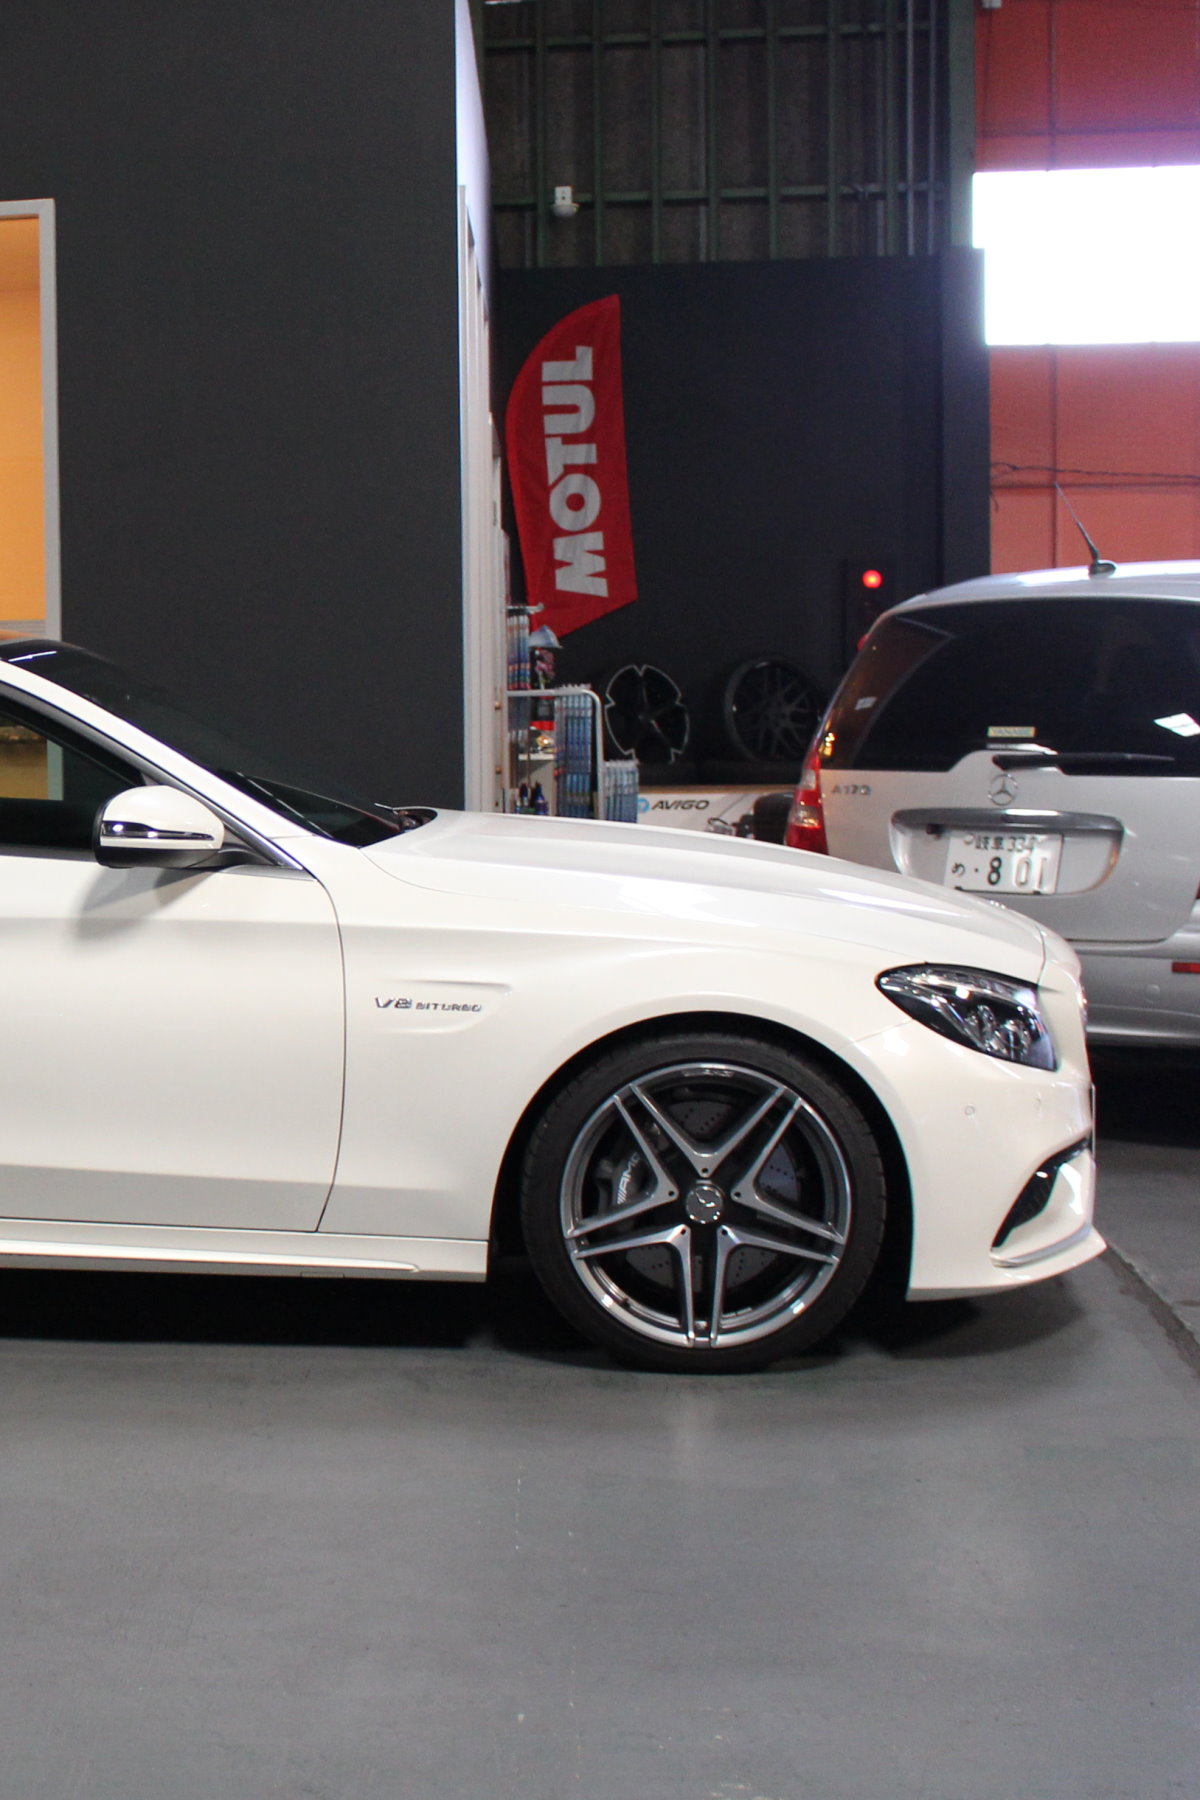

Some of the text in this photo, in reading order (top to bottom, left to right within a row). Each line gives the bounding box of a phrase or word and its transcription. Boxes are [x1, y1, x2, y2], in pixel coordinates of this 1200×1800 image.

[541, 345, 609, 598] MOTUL
[651, 799, 710, 811] AVIGO
[375, 997, 482, 1013] V8 BITURBO
